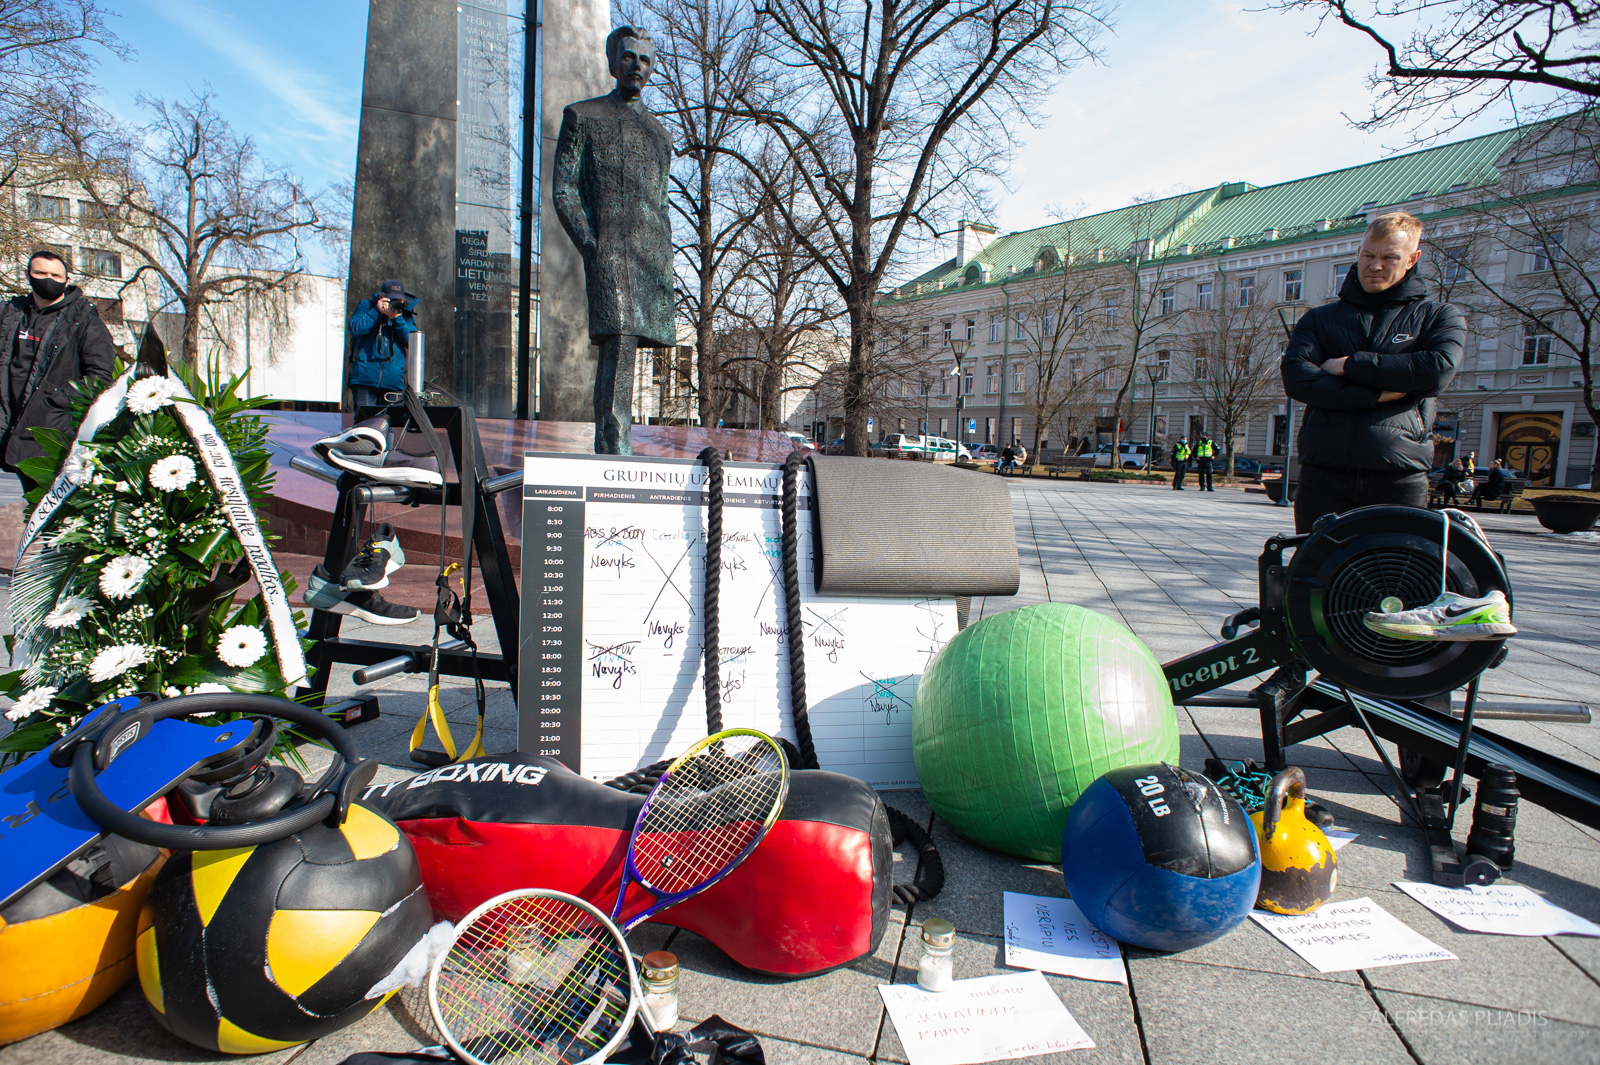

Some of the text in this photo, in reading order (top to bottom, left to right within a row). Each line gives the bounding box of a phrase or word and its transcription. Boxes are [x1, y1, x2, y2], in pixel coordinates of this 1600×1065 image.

[465, 15, 494, 28] TEGUL
[461, 237, 486, 247] DEGA
[457, 267, 516, 283] LIETUVOS
[459, 257, 495, 269] VARDAN
[603, 469, 685, 487] GRUPINIŲ
[691, 471, 779, 491] UŽĖMIMŲ
[649, 494, 692, 502] ANTRADIENIS
[704, 496, 746, 504] TDIENIS
[590, 553, 636, 580] Nevyks
[702, 556, 747, 580] vyks
[647, 620, 685, 649] Nevyks
[814, 636, 845, 664] Nevyks
[592, 660, 637, 690] Nevyks
[1167, 647, 1260, 691] ncept 2
[362, 762, 551, 801] TY BOXING
[1134, 775, 1172, 817] 20 LB
[1036, 903, 1055, 948] NERŪPIU
[1063, 921, 1080, 941] NES
